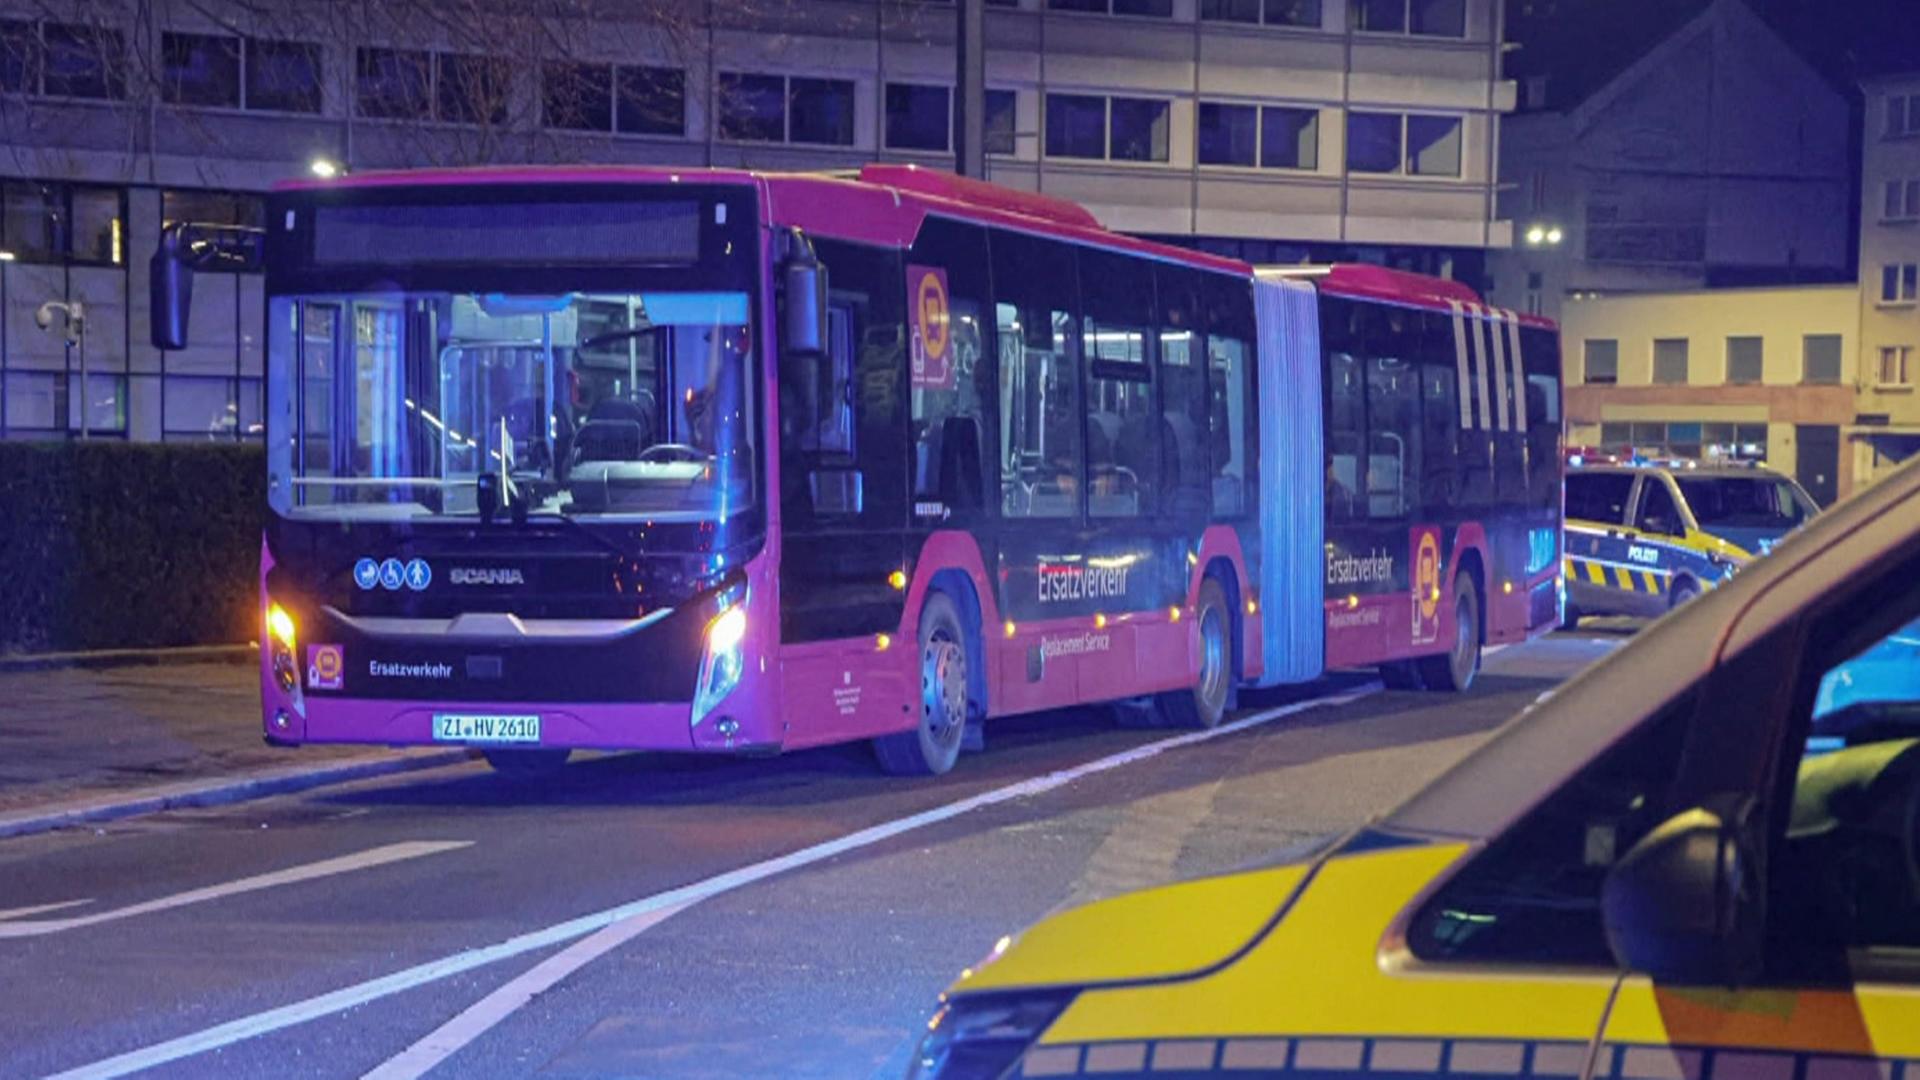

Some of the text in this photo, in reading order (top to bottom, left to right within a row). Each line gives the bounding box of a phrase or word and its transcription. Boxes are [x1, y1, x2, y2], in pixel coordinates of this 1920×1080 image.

[1327, 547, 1393, 584] Ersatzverkehr
[450, 568, 524, 584] SCANIA
[1038, 561, 1128, 602] Ersatzverkehr
[369, 660, 452, 678] Ersatzverkehr
[443, 718, 537, 736] ZI HV 2610
